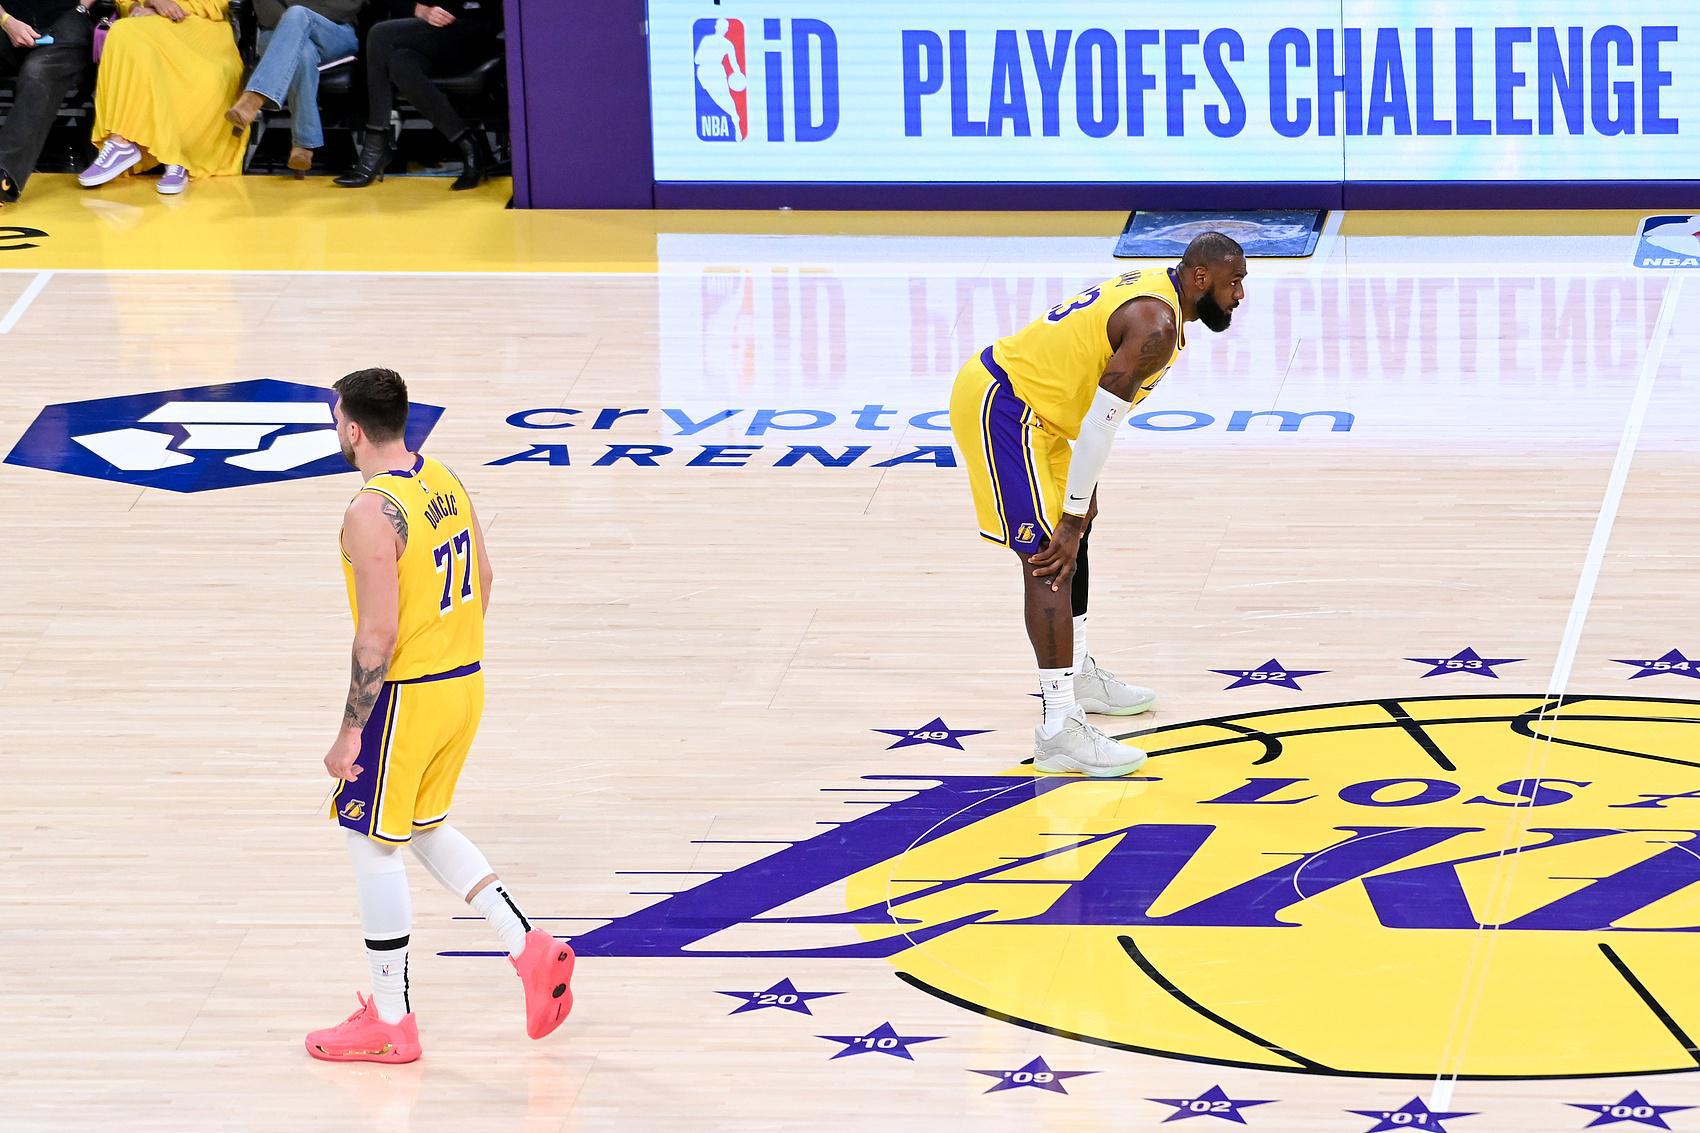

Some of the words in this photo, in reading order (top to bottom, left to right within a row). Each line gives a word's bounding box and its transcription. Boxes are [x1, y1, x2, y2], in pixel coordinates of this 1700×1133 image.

[764, 18, 840, 142] iD
[902, 27, 1247, 138] PLAYOFFS
[1269, 24, 1679, 138] CHALLENGE
[701, 115, 730, 137] NBA
[1641, 257, 1700, 267] NBA
[1048, 284, 1101, 323] 3
[484, 444, 958, 468] ARENA
[423, 491, 459, 530] DONČIĆ
[432, 528, 475, 618] 77
[1437, 659, 1483, 669] '53
[1644, 661, 1691, 671] '54
[1241, 671, 1288, 681] '52
[907, 730, 949, 741] '49
[1197, 778, 1593, 808] LOS
[752, 992, 799, 1005] '20
[853, 1037, 899, 1049] '10
[1003, 1071, 1055, 1084] '09
[1181, 1100, 1232, 1113] '02
[1601, 1105, 1655, 1119] '00
[1382, 1112, 1429, 1125] '01
